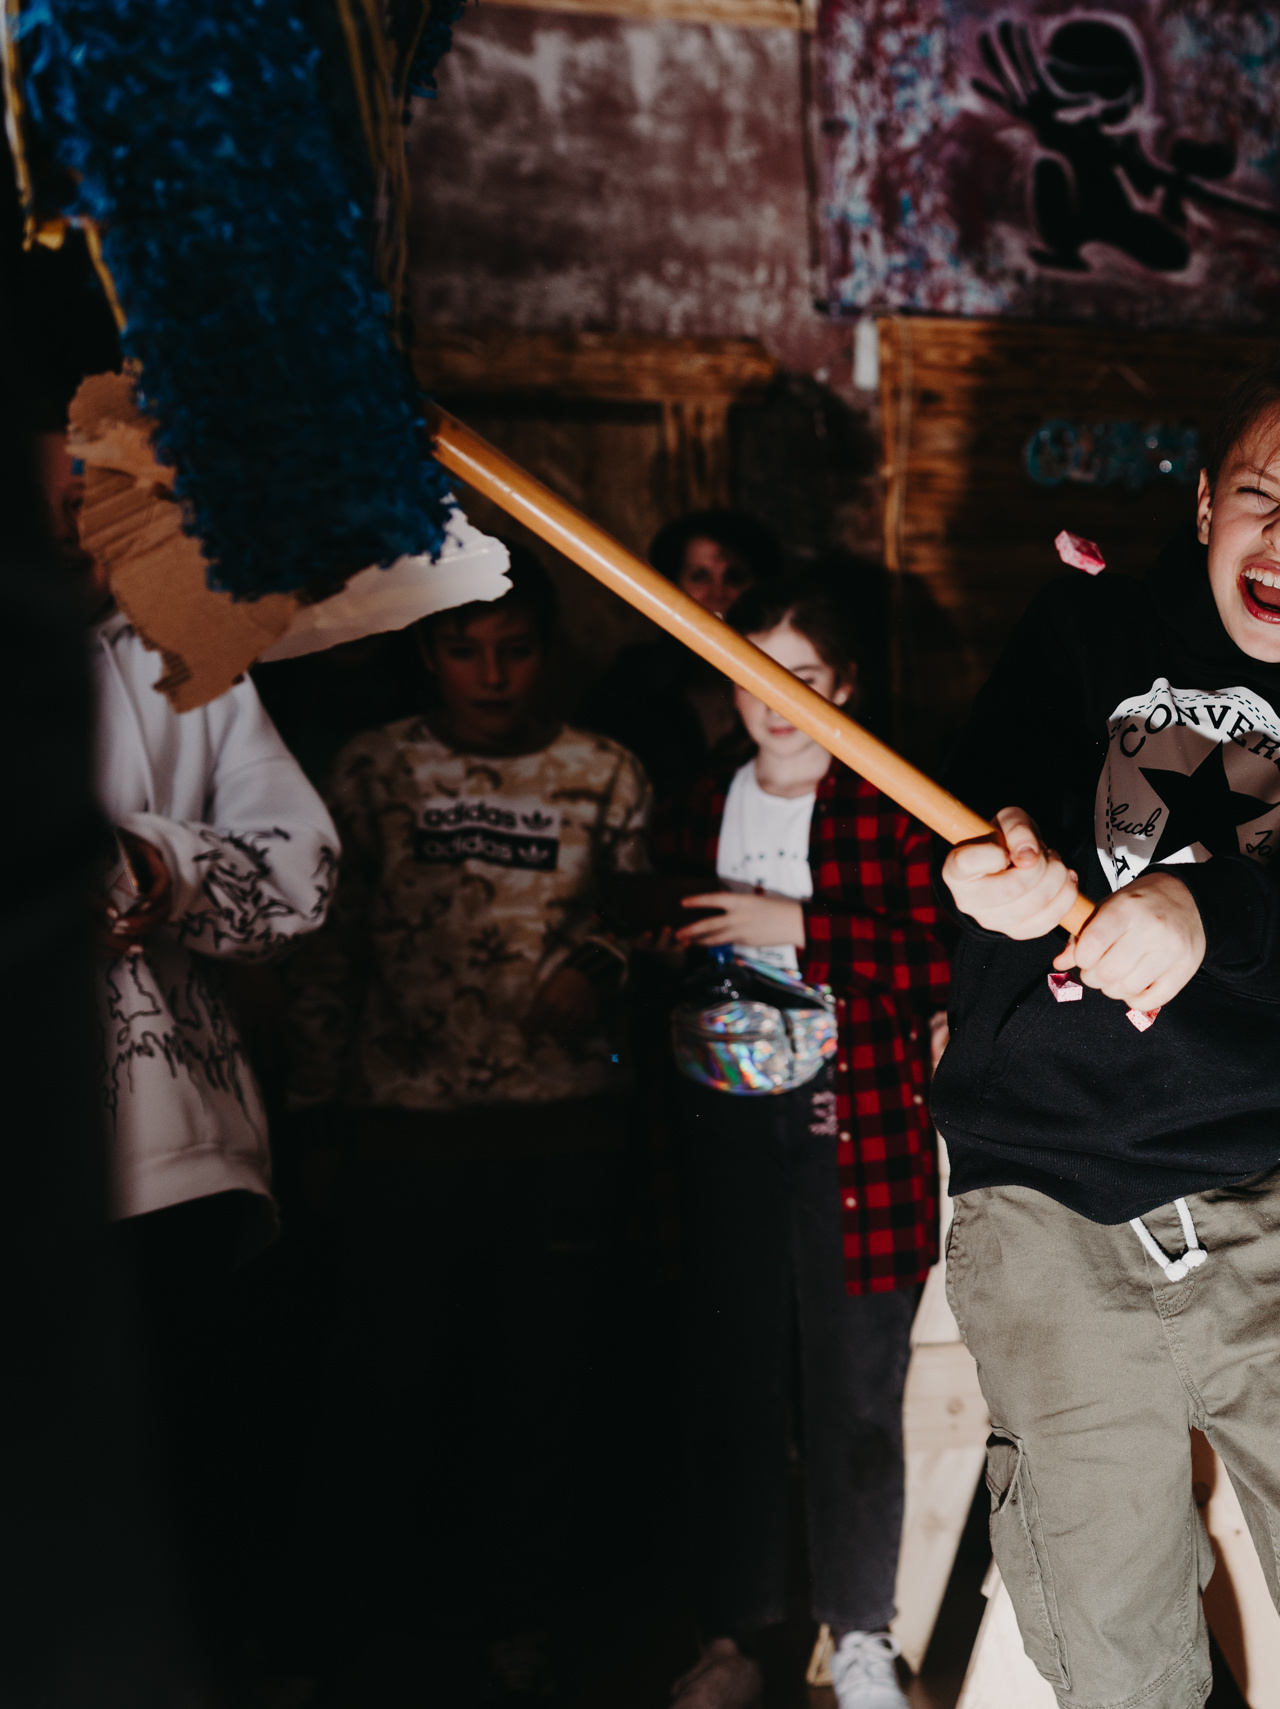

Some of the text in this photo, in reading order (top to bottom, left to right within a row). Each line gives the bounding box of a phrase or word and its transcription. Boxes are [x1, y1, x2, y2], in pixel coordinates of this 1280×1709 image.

[424, 802, 516, 829] adidas
[1110, 802, 1163, 838] huck
[423, 832, 514, 862] adidas
